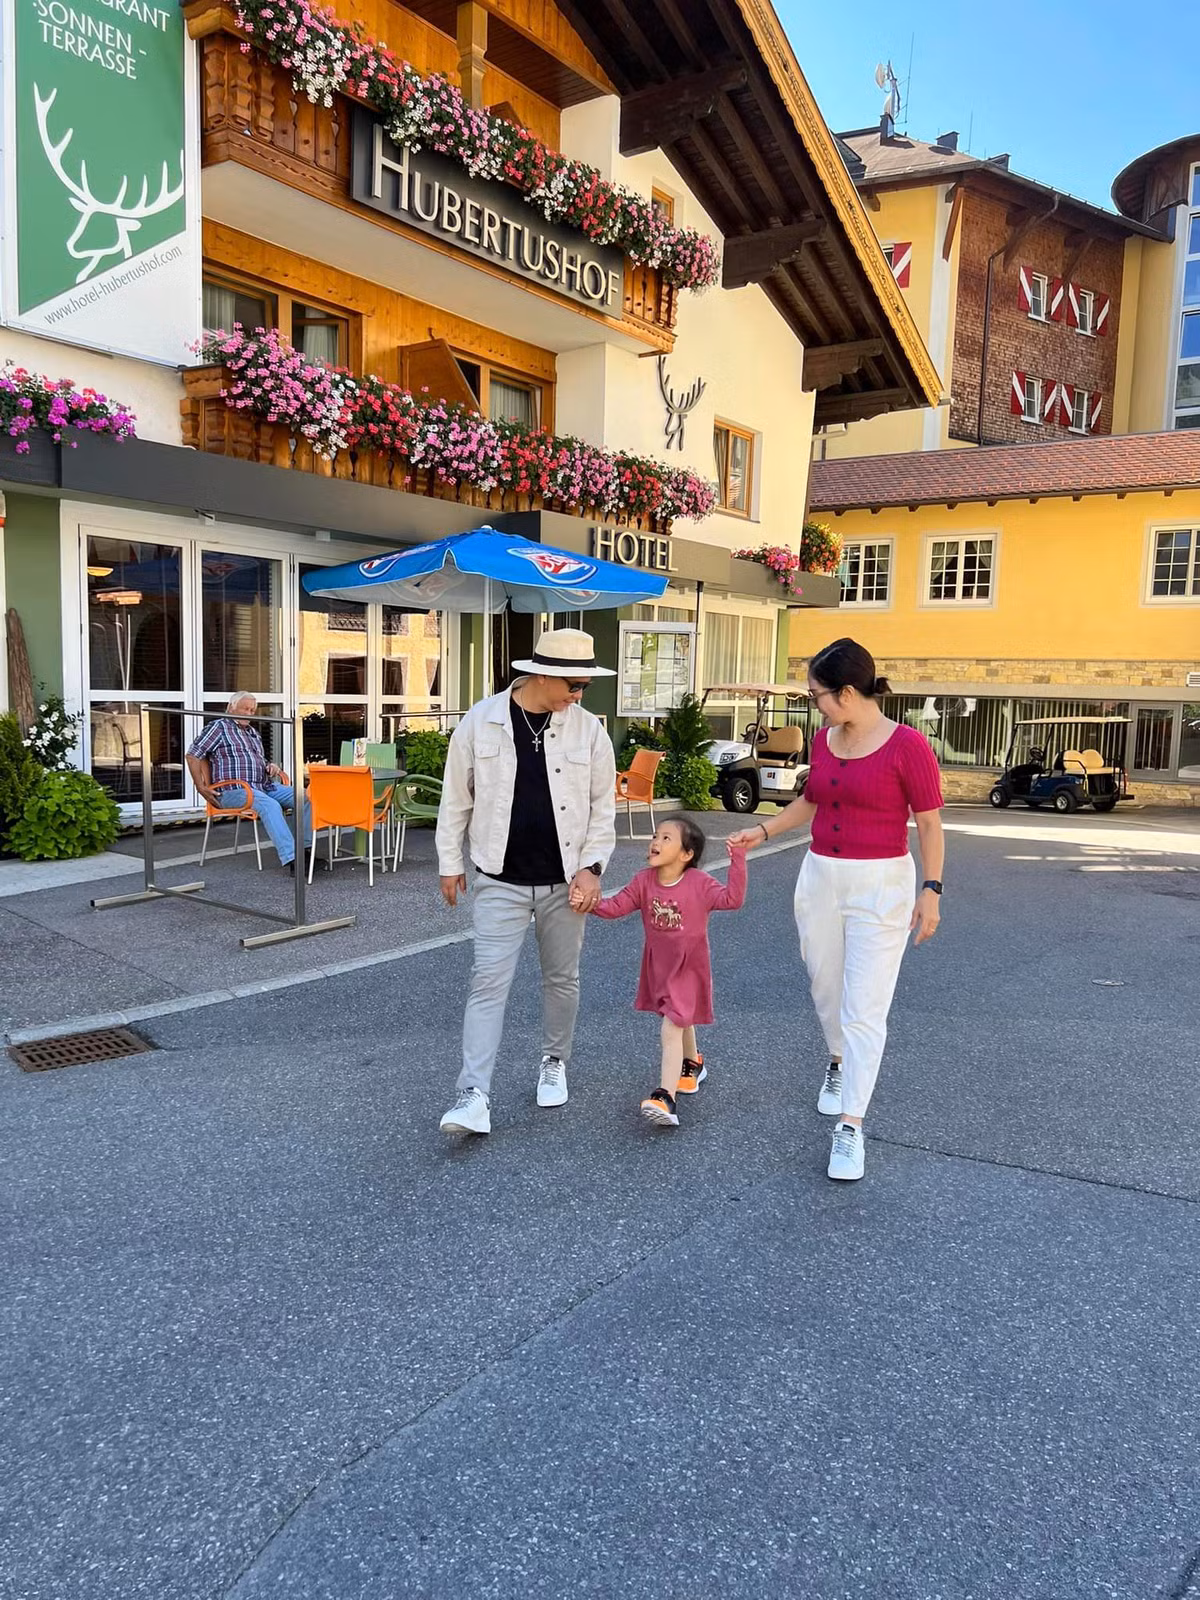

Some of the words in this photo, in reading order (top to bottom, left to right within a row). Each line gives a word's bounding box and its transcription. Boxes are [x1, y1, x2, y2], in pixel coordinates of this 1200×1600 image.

[38, 19, 137, 80] TERRASSE
[371, 123, 620, 306] HUBERTUSHOF
[44, 246, 183, 325] www.hotel-hubertushof.com
[596, 526, 679, 572] HOTEL
